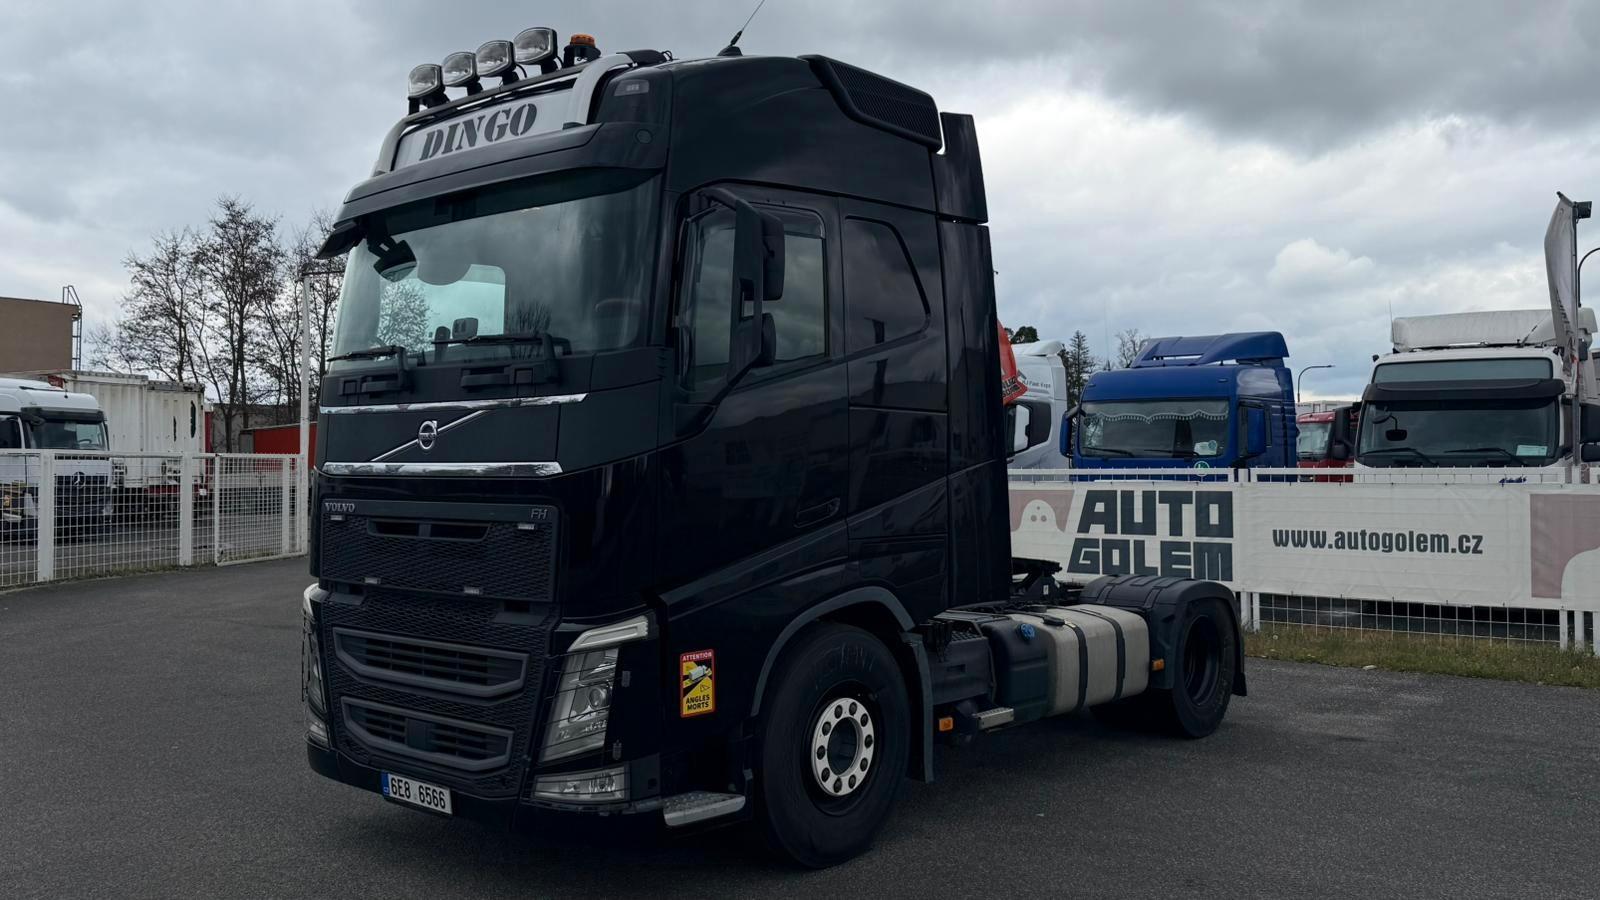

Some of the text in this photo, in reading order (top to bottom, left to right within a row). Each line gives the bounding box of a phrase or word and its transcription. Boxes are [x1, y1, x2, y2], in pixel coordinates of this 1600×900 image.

[419, 103, 537, 161] DINGO
[324, 502, 355, 512] VOLVO
[531, 508, 548, 520] FH
[1077, 490, 1233, 538] AUTO
[1272, 529, 1483, 554] www.autogolem.cz
[1067, 538, 1233, 581] GOLEM
[682, 651, 712, 661] ATTENTION
[686, 694, 710, 704] ANGLES
[687, 702, 709, 711] MORTS
[391, 777, 446, 809] 6E8 6566
